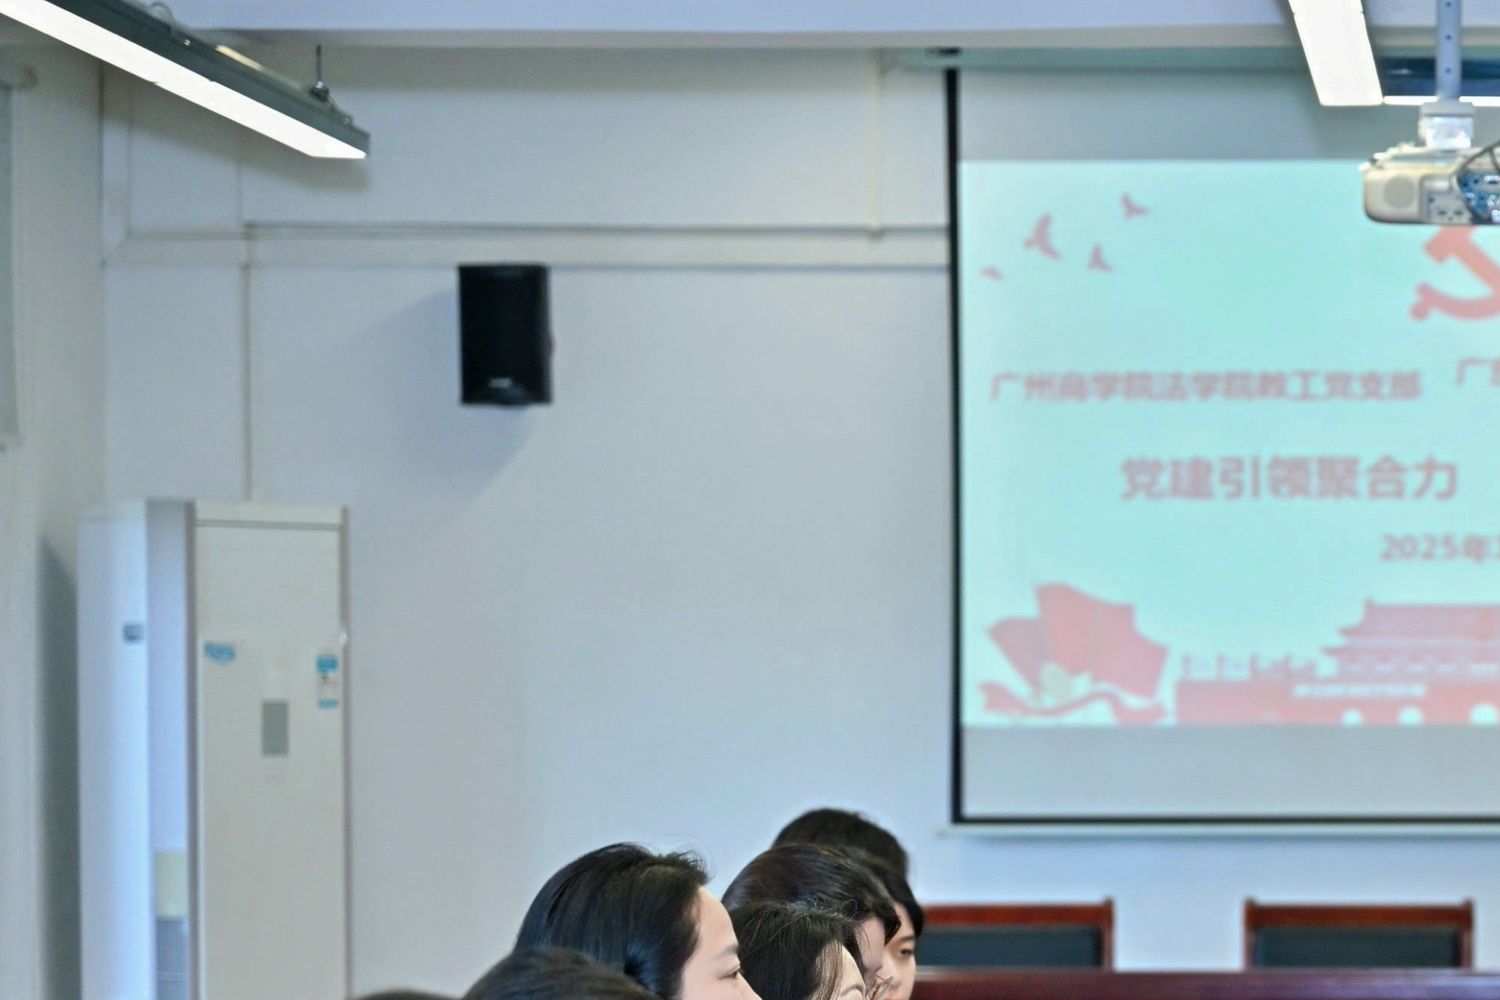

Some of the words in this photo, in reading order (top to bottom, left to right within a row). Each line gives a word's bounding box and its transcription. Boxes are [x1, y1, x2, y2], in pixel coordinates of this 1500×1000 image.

[1120, 454, 1459, 501] 党建引领聚合力
